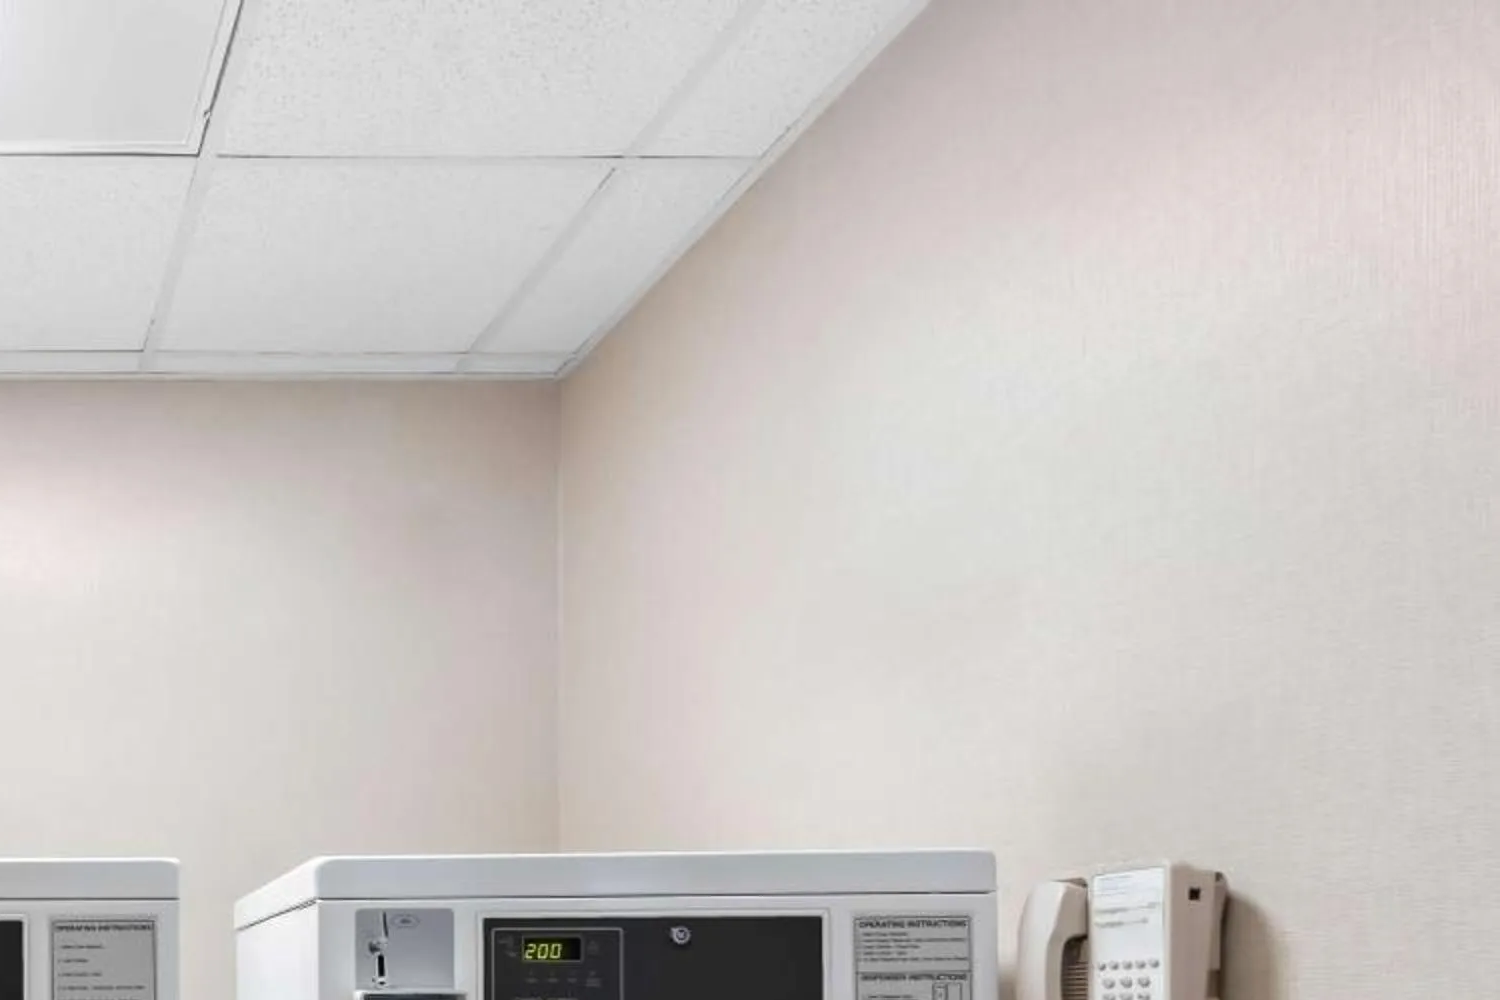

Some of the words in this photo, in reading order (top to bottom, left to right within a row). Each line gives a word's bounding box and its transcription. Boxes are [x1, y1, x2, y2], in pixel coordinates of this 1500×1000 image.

[859, 920, 905, 928] OPERATING
[907, 919, 967, 928] INSTRUCTIONS
[524, 943, 562, 959] 200
